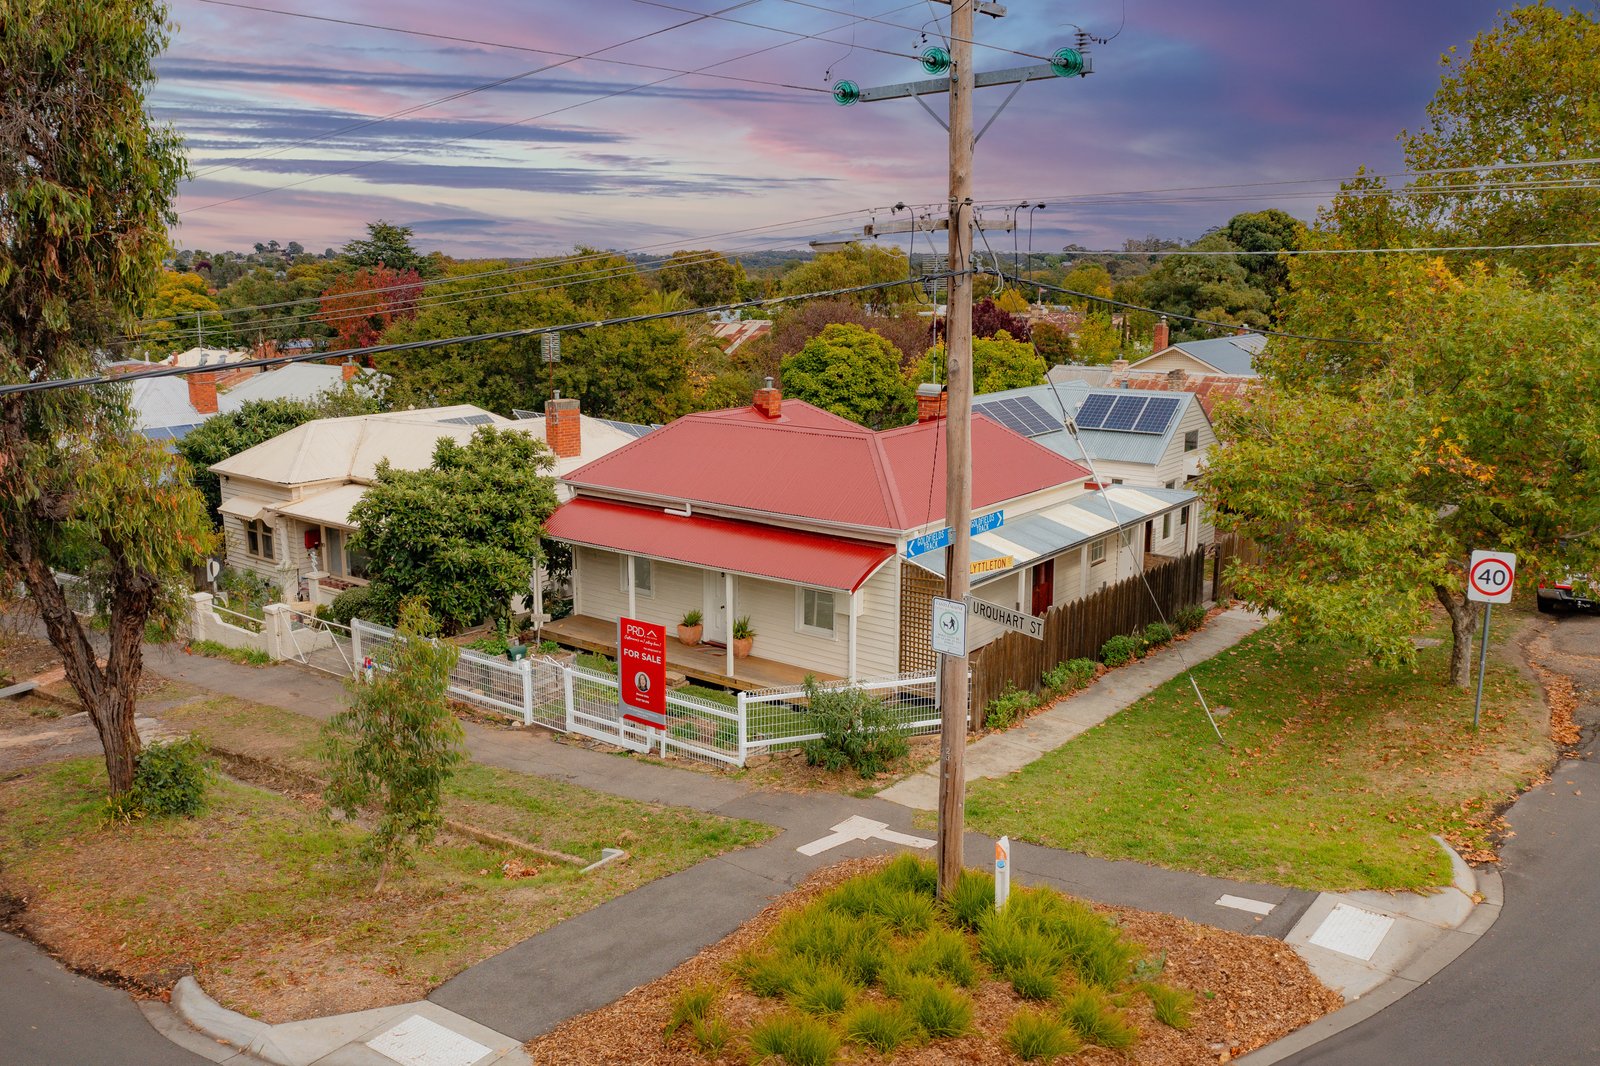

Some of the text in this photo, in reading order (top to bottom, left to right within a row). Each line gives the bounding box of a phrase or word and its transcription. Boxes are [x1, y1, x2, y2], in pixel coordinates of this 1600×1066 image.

[971, 513, 995, 528] GOLDFIELDS
[976, 523, 989, 534] TRACK
[917, 530, 945, 547] GOLDFIELDS
[923, 540, 938, 552] TRACK
[970, 558, 1007, 574] LYTTLETON
[1477, 568, 1506, 586] 40
[973, 601, 1024, 630] URQUHART
[1030, 621, 1042, 636] ST
[623, 648, 640, 659] FOR
[641, 652, 662, 665] SALE
